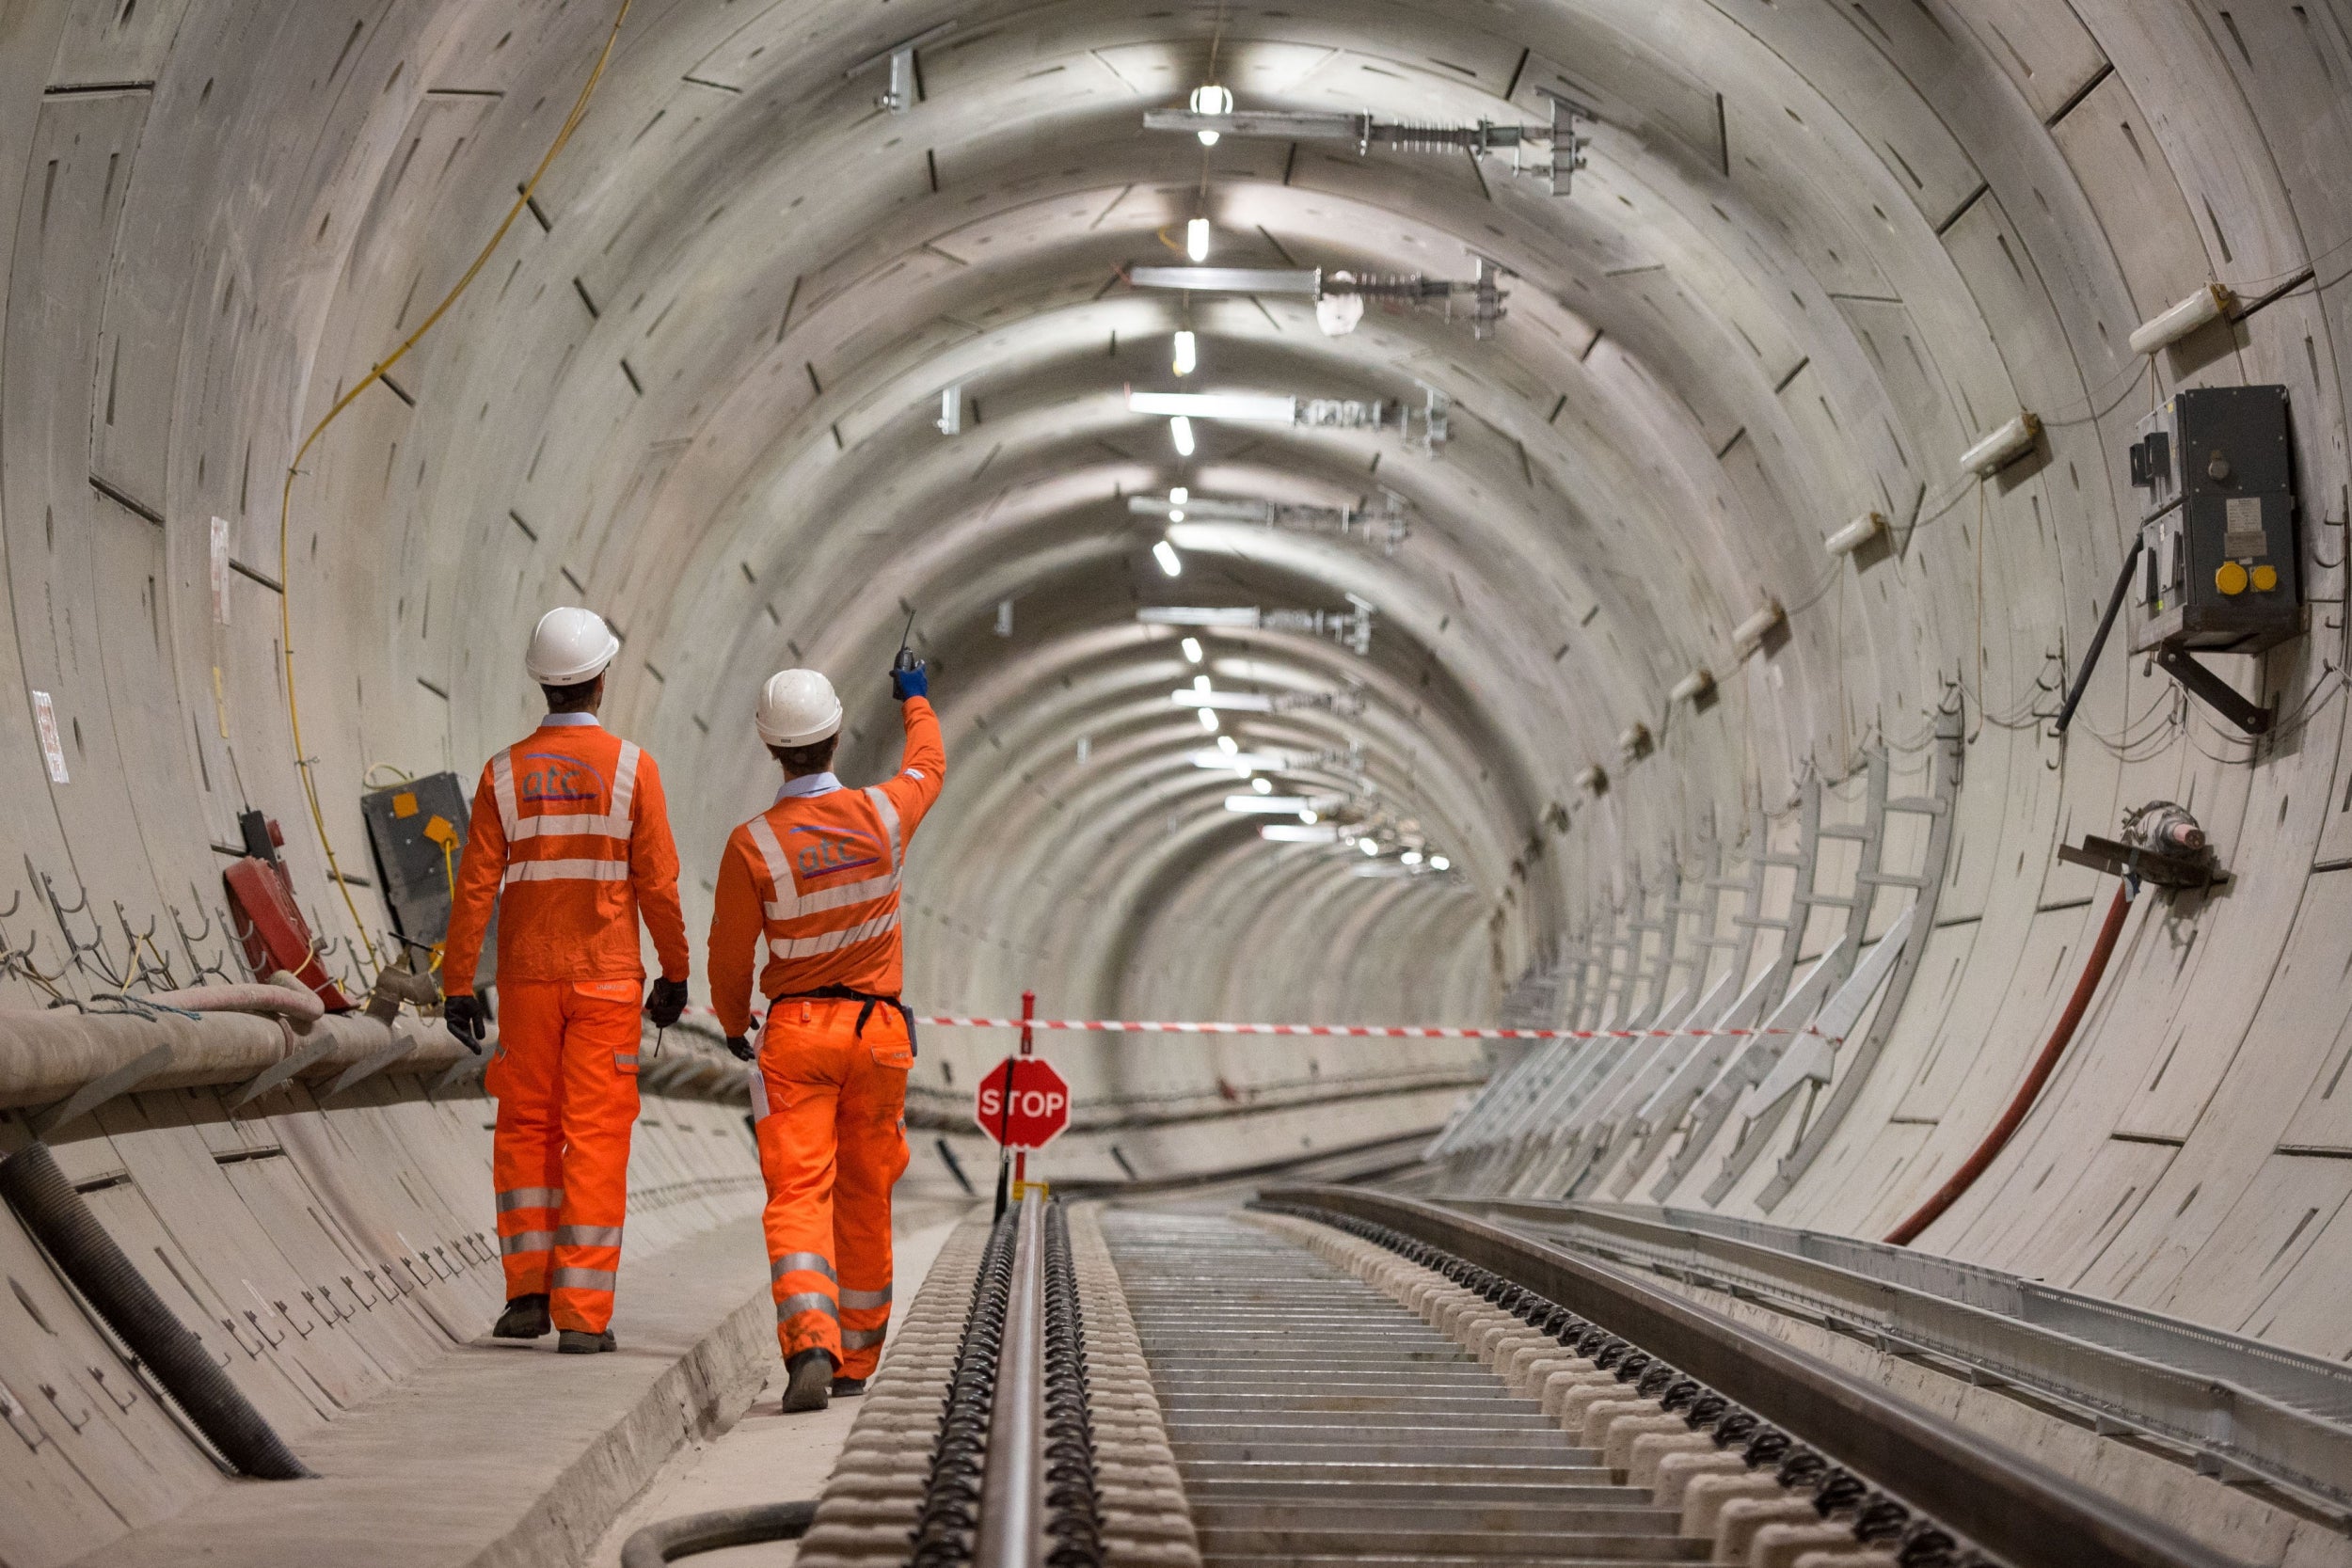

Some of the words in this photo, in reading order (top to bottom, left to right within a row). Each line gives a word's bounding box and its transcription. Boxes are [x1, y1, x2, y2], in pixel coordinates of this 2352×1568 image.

[522, 766, 580, 797] atc
[798, 836, 857, 873] atc
[981, 1089, 1064, 1117] STOP
